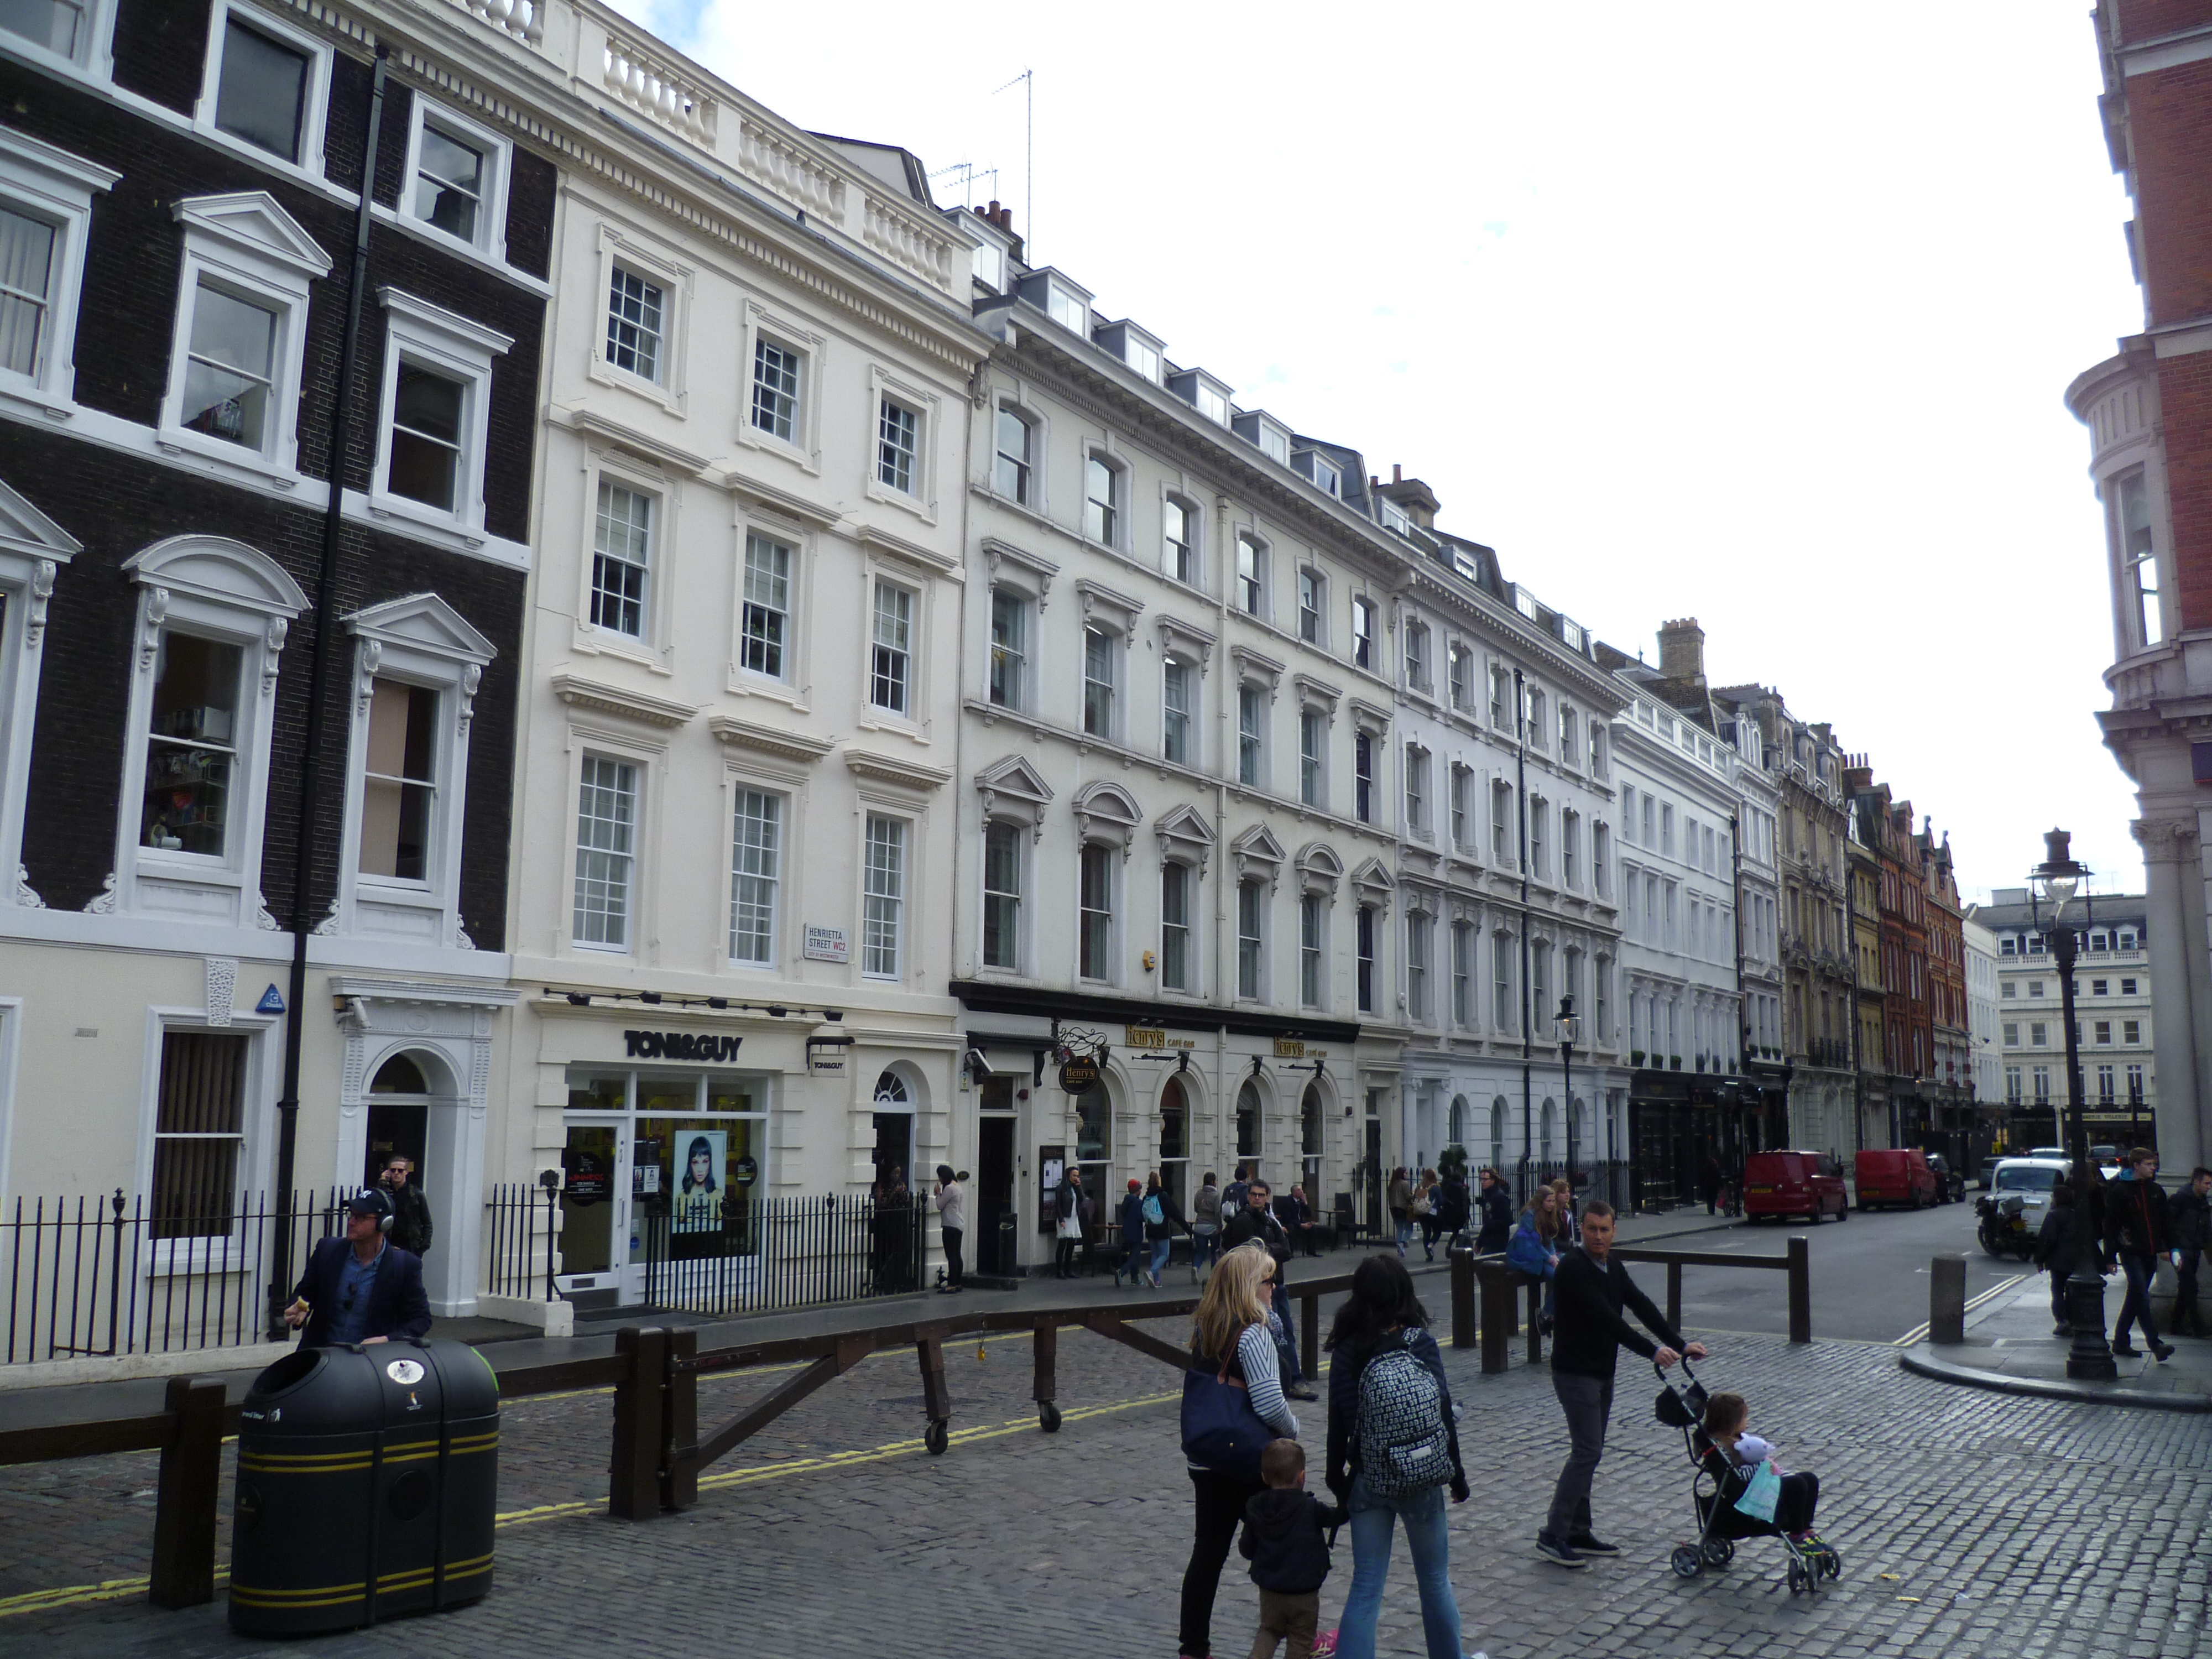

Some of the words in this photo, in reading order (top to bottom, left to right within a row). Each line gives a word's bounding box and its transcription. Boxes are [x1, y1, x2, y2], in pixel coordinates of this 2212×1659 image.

[809, 927, 843, 940] HENRIETTA
[809, 938, 832, 949] STREET
[833, 941, 846, 951] WC2
[1125, 1024, 1164, 1048] Henry's
[624, 1030, 744, 1062] TONI&GUY
[1274, 1036, 1304, 1058] Henry's
[1066, 1067, 1094, 1079] Henry's
[589, 1080, 599, 1099] 4
